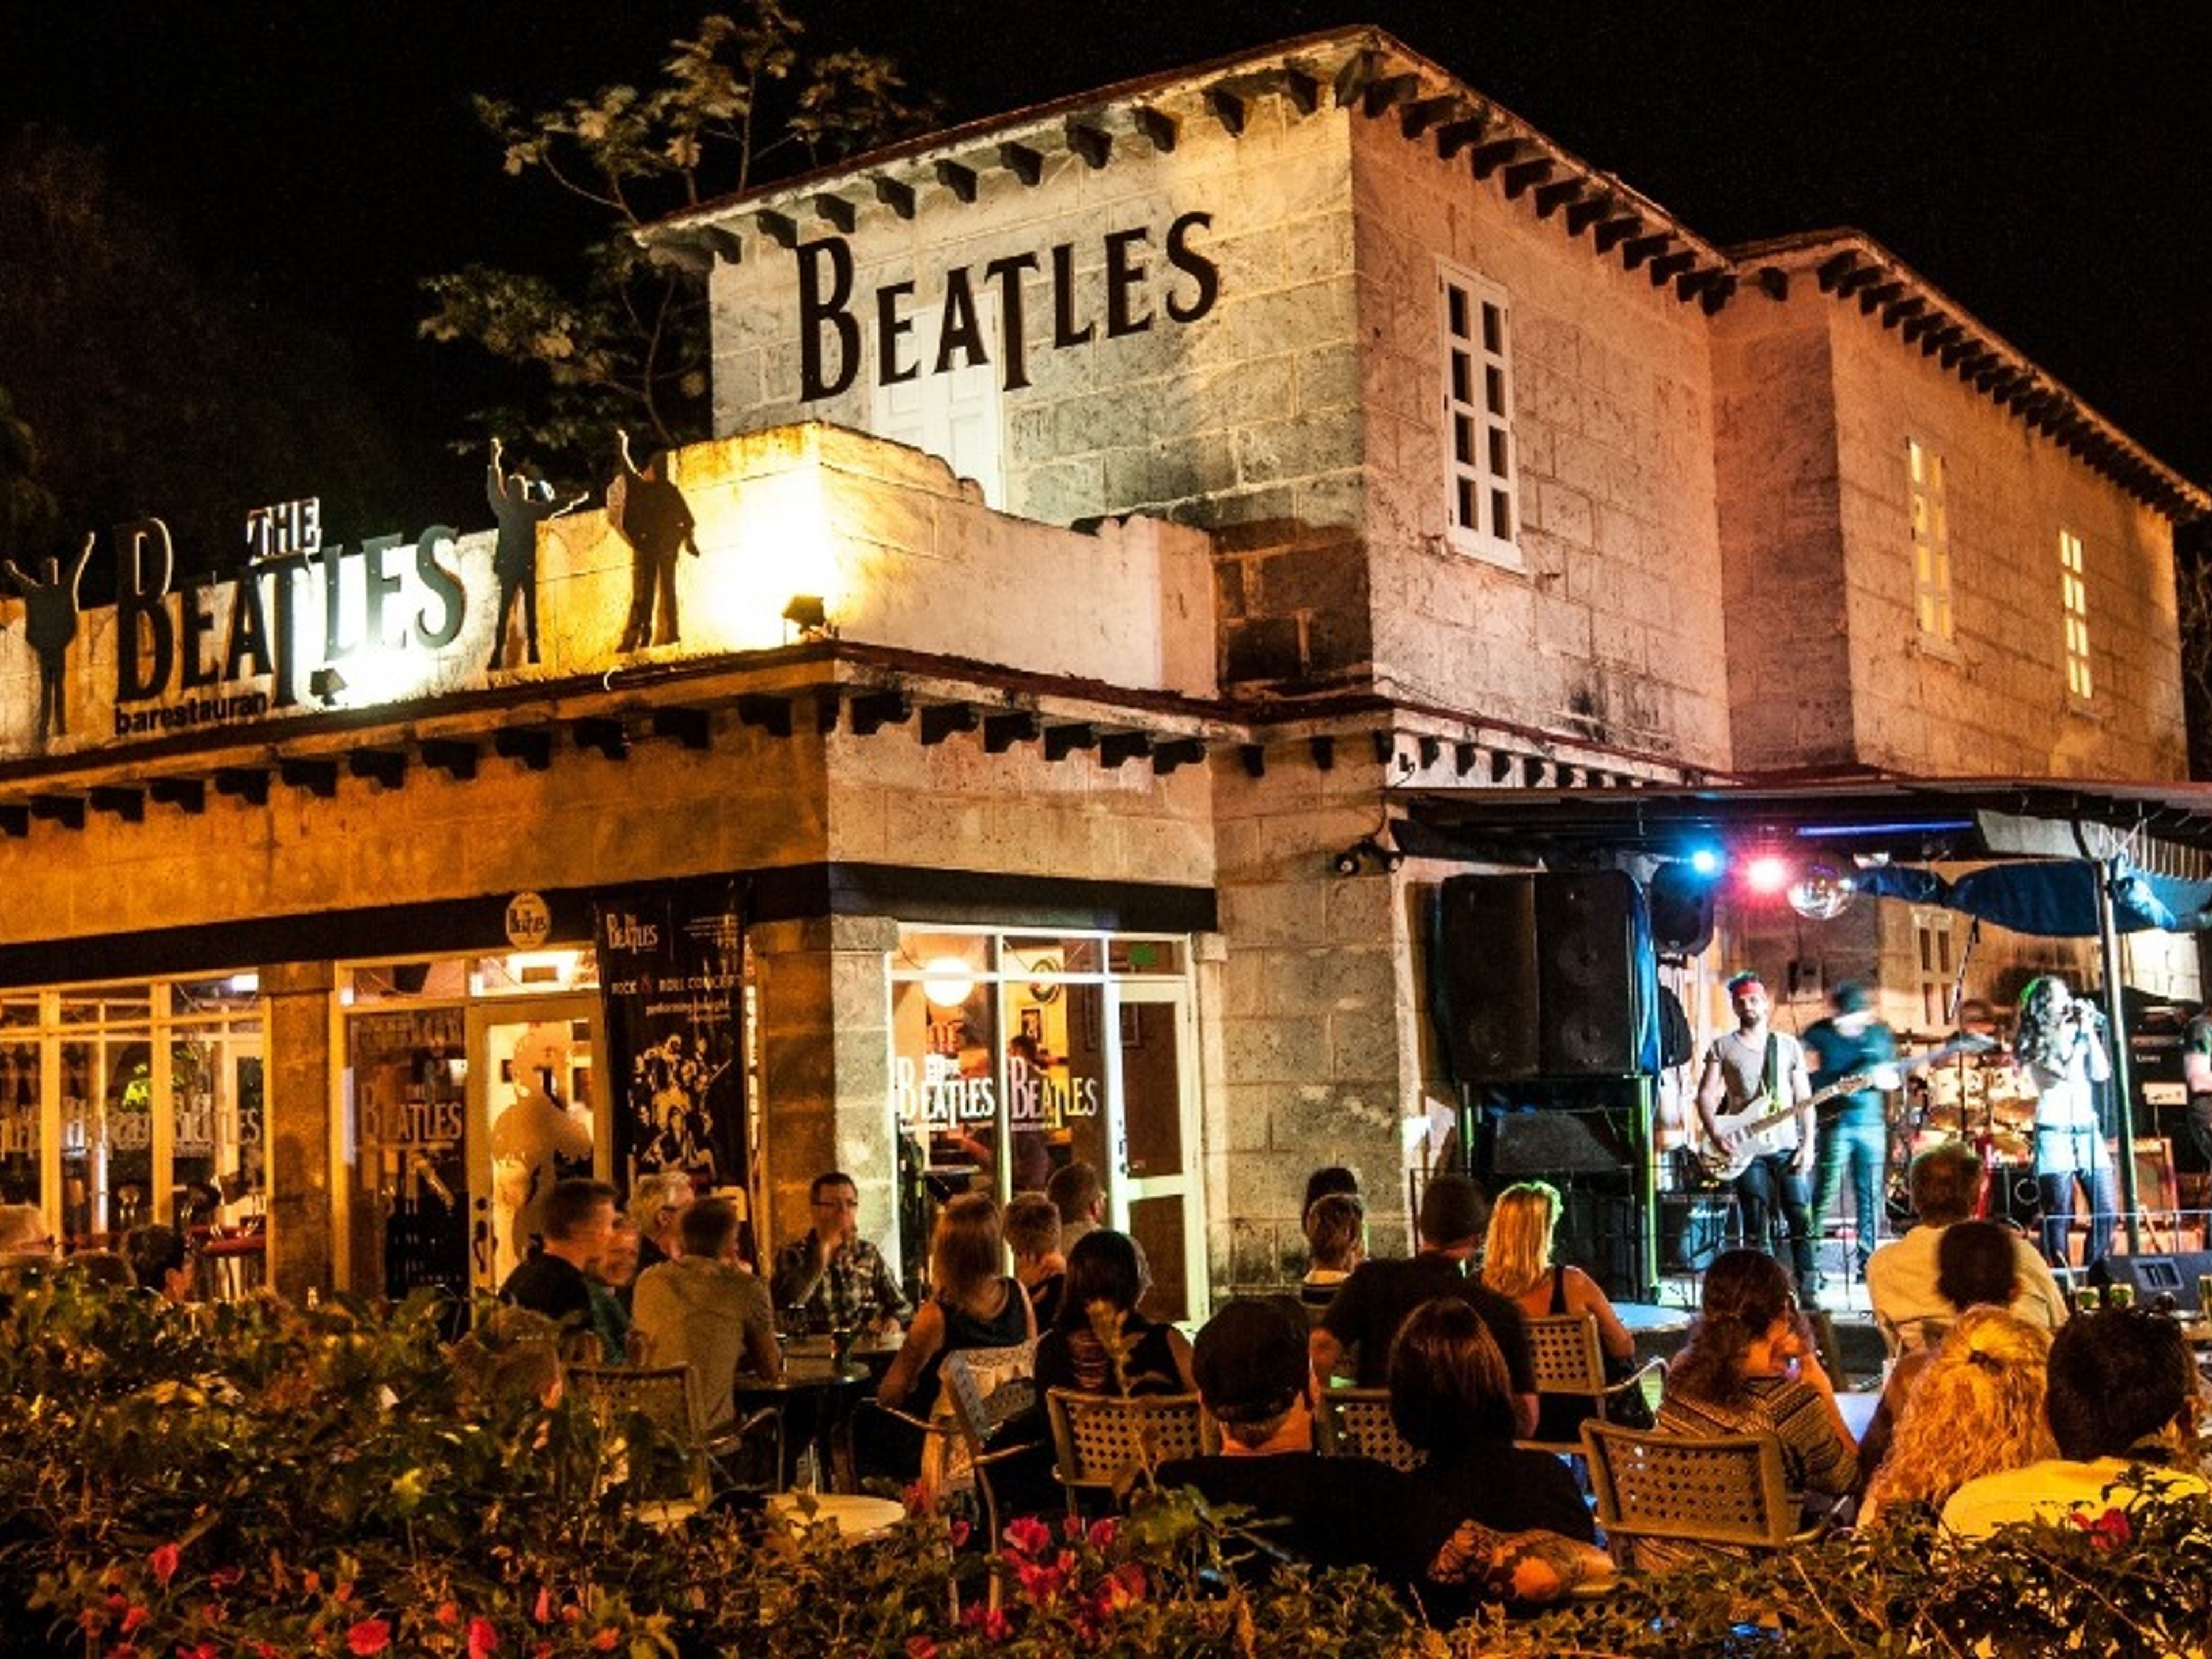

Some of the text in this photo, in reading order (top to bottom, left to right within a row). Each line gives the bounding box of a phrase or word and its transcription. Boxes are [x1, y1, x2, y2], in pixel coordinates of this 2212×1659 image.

[796, 211, 1219, 402] BEATLES
[247, 497, 322, 555] THE
[115, 517, 466, 707] BEATLES
[896, 1056, 995, 1129] BEATLES
[1010, 1056, 1098, 1128] BEATLES
